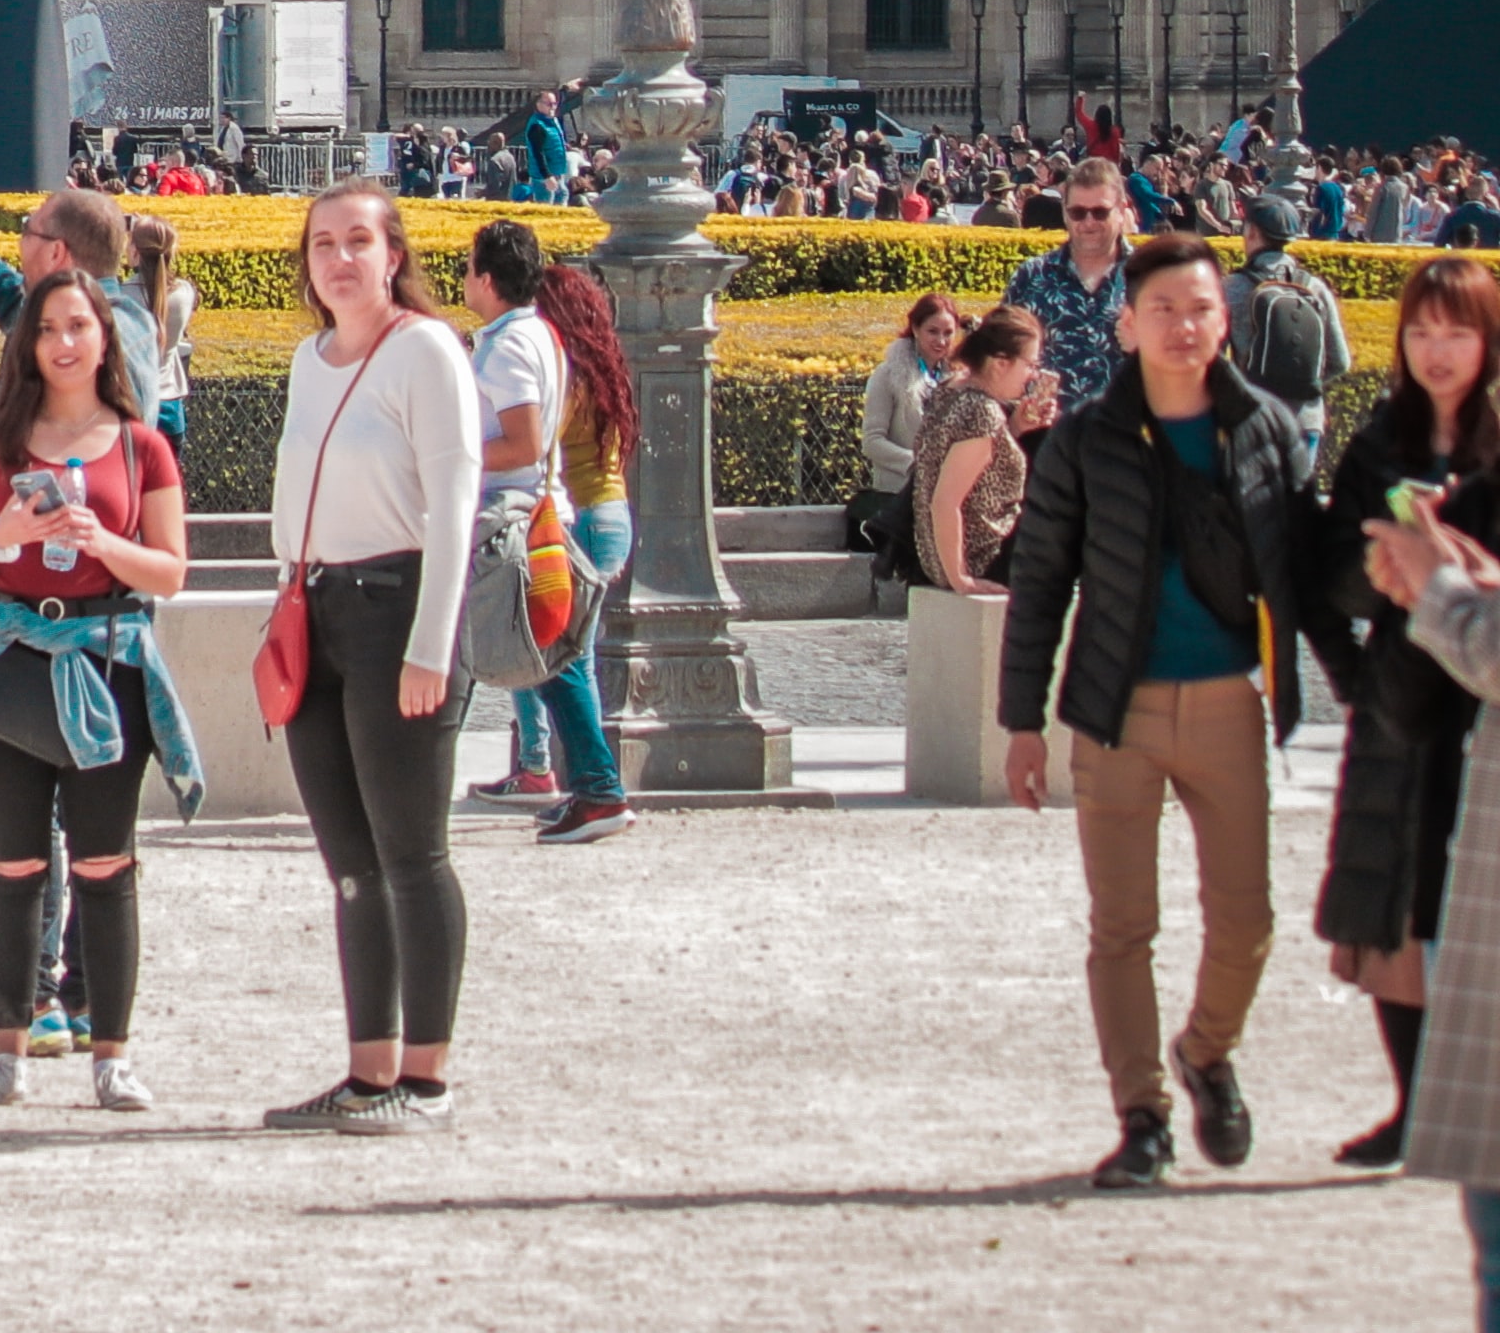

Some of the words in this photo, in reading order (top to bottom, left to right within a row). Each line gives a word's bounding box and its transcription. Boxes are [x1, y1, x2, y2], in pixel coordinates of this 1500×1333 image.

[67, 31, 94, 58] RE
[114, 106, 129, 120] 26
[138, 106, 153, 121] 31
[153, 106, 189, 120] MARS
[189, 106, 211, 120] 201
